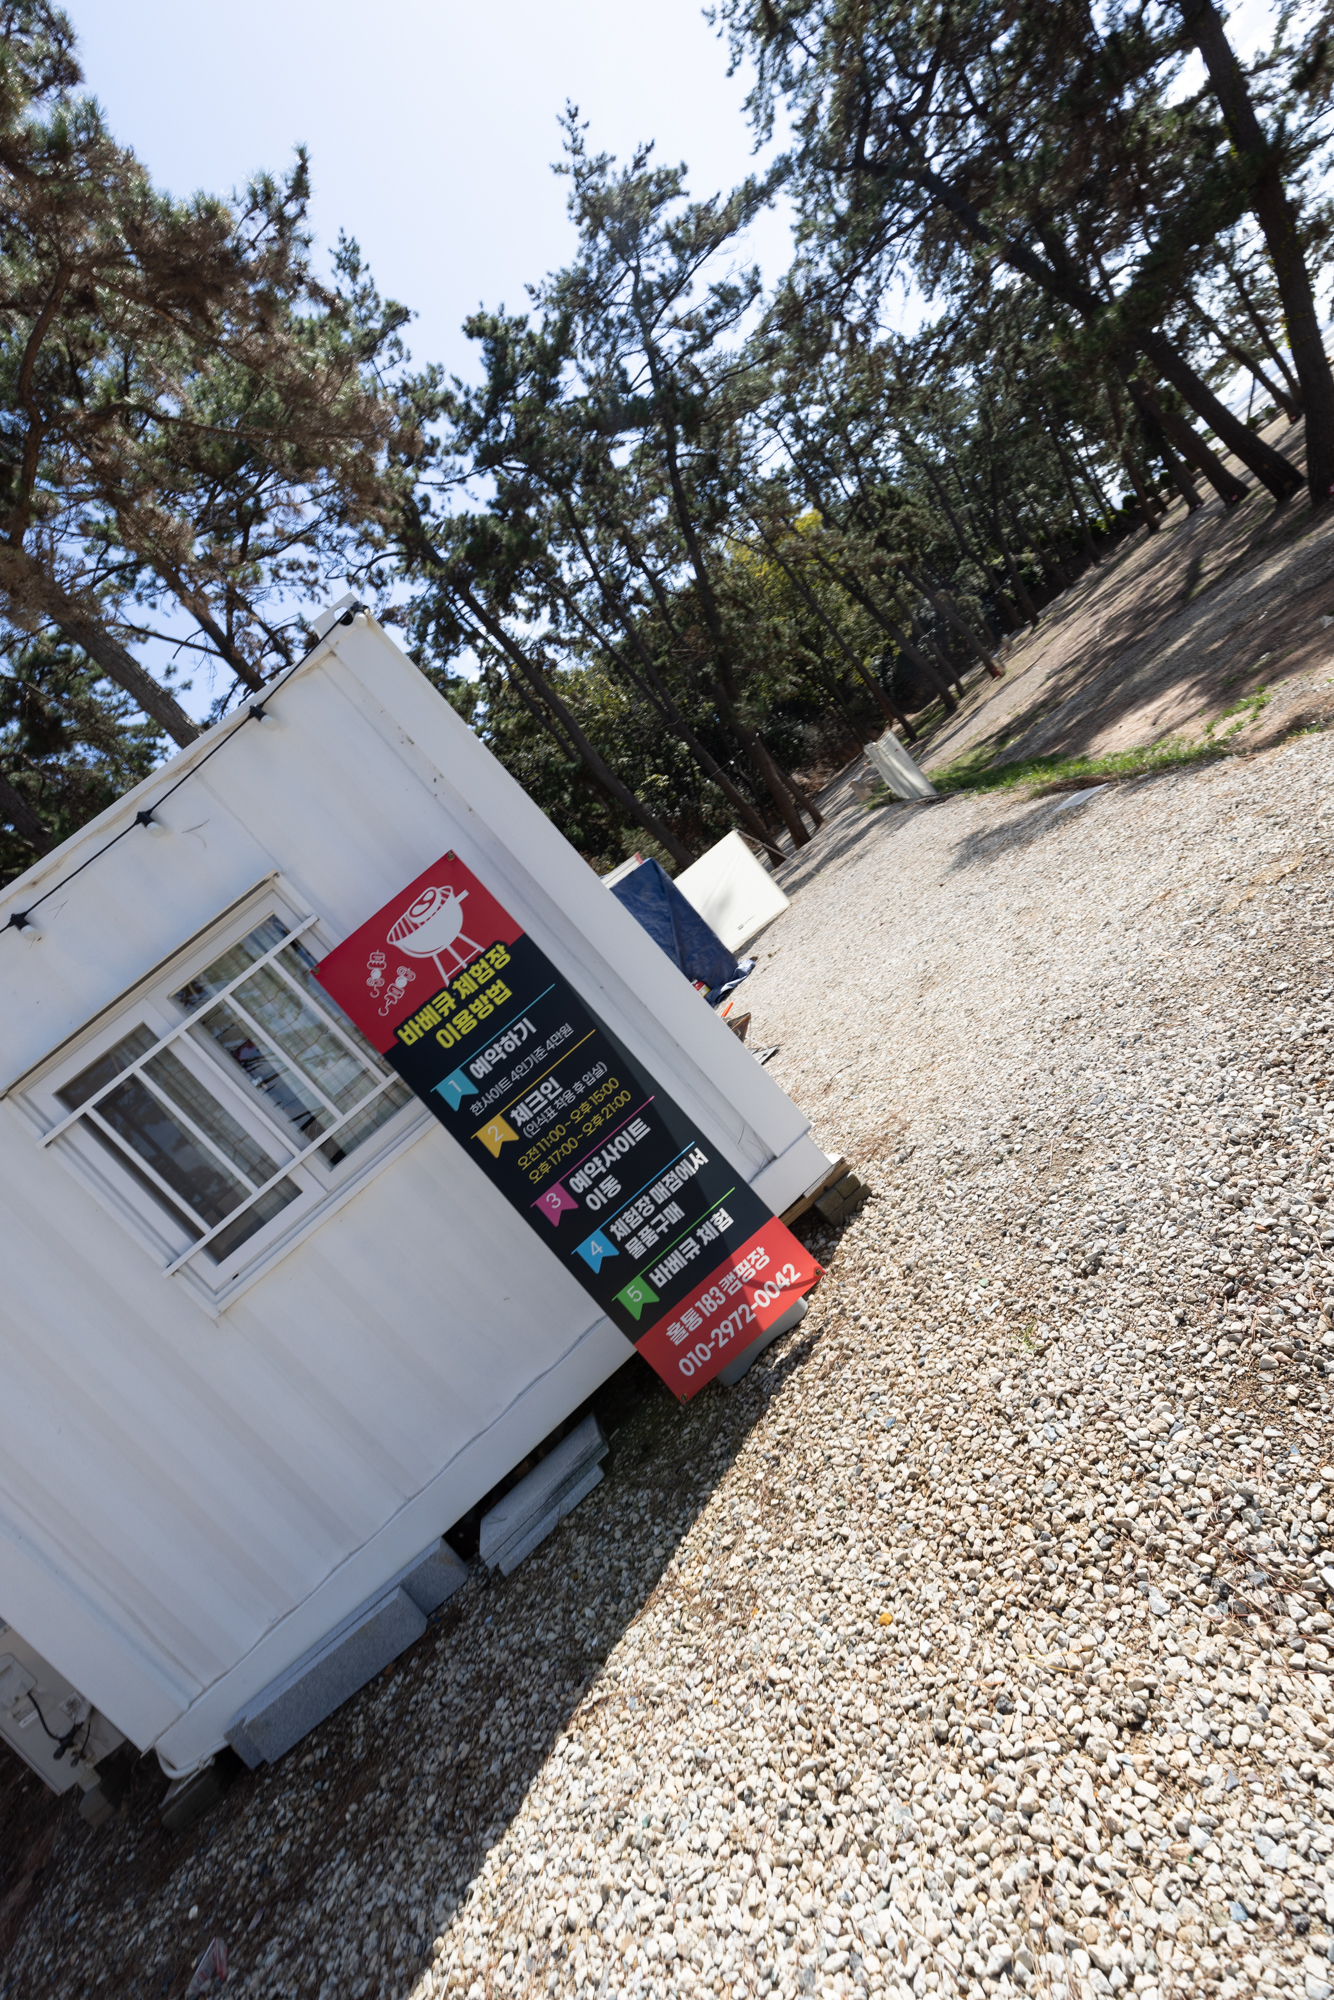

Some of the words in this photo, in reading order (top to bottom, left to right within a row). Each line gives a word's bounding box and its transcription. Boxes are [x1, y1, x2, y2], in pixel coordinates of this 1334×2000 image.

[397, 990, 457, 1046] 바베큐
[451, 943, 511, 1000] 체험장
[435, 978, 513, 1049] 이용방법
[447, 1079, 462, 1093] 1
[469, 1017, 537, 1079] 예약하기
[469, 1076, 514, 1117] 한사이트
[510, 1045, 549, 1082] 4인기준
[545, 1022, 575, 1051] 4만원
[522, 1105, 559, 1139] (인식표
[553, 1089, 577, 1110] 착용
[571, 1080, 586, 1095] 후
[581, 1061, 608, 1087] 입실)
[487, 1125, 504, 1143] 2
[509, 1076, 564, 1128] 체크인
[517, 1145, 542, 1171] 오전
[535, 1124, 567, 1152] 11:00
[569, 1100, 593, 1124] 오후
[587, 1077, 620, 1106] 15:00
[528, 1160, 552, 1185] 오후
[547, 1136, 579, 1166] 17:00
[582, 1113, 605, 1137] 오후
[600, 1089, 632, 1120] 21:00
[545, 1192, 562, 1209] 3
[568, 1117, 651, 1194] 예약사이트
[585, 1174, 622, 1211] 이동
[590, 1240, 604, 1256] 4
[609, 1194, 656, 1242] 체험장
[648, 1147, 709, 1205] 매점에서
[624, 1200, 686, 1260] 물품구매
[626, 1284, 643, 1303] 5
[648, 1236, 701, 1289] 바베큐
[696, 1207, 735, 1246] 체험
[665, 1306, 704, 1346] 홀통
[694, 1286, 726, 1318] 183
[718, 1245, 771, 1296] 캠핑장
[678, 1262, 802, 1376] 010-2972-0042
